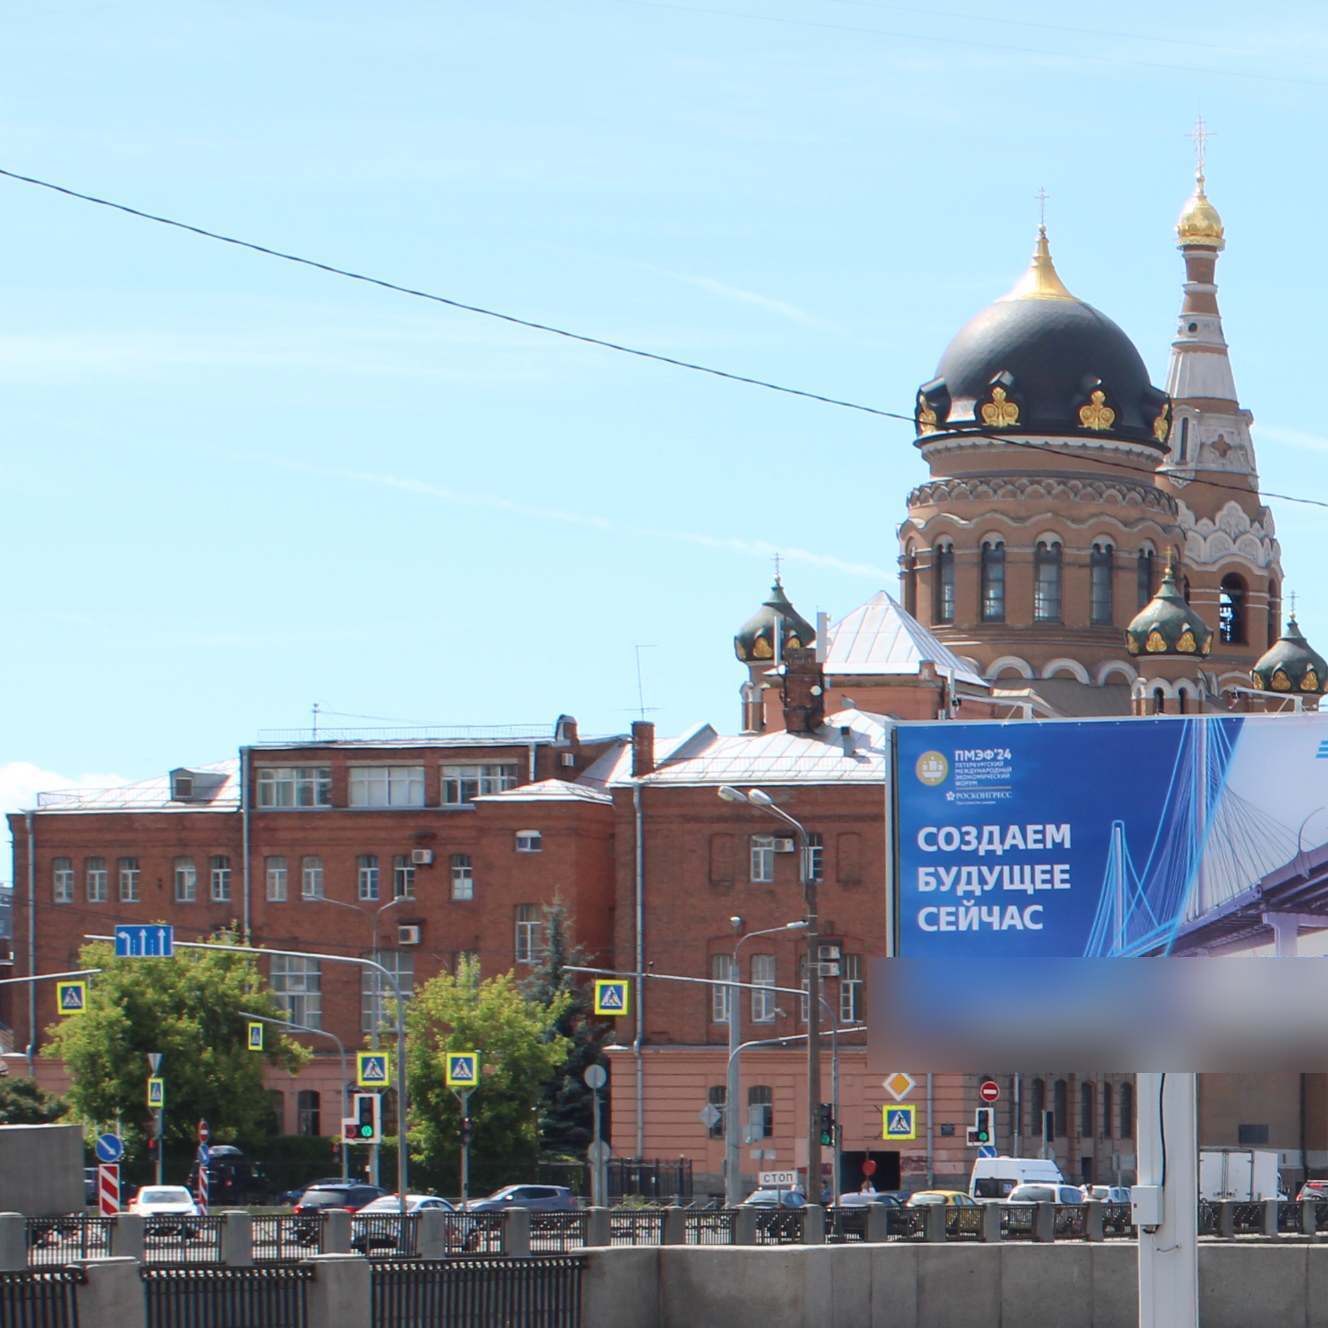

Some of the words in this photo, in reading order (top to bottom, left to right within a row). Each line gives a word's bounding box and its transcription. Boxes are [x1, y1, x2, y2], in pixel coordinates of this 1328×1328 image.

[955, 791, 1013, 800] РОСКОНГРЕСС
[917, 823, 1072, 856] СОЗДАЕМ
[917, 864, 1071, 896] БУДУЩЕЕ
[917, 899, 1044, 932] СЕЙЧАС
[763, 1173, 793, 1183] СТОП
